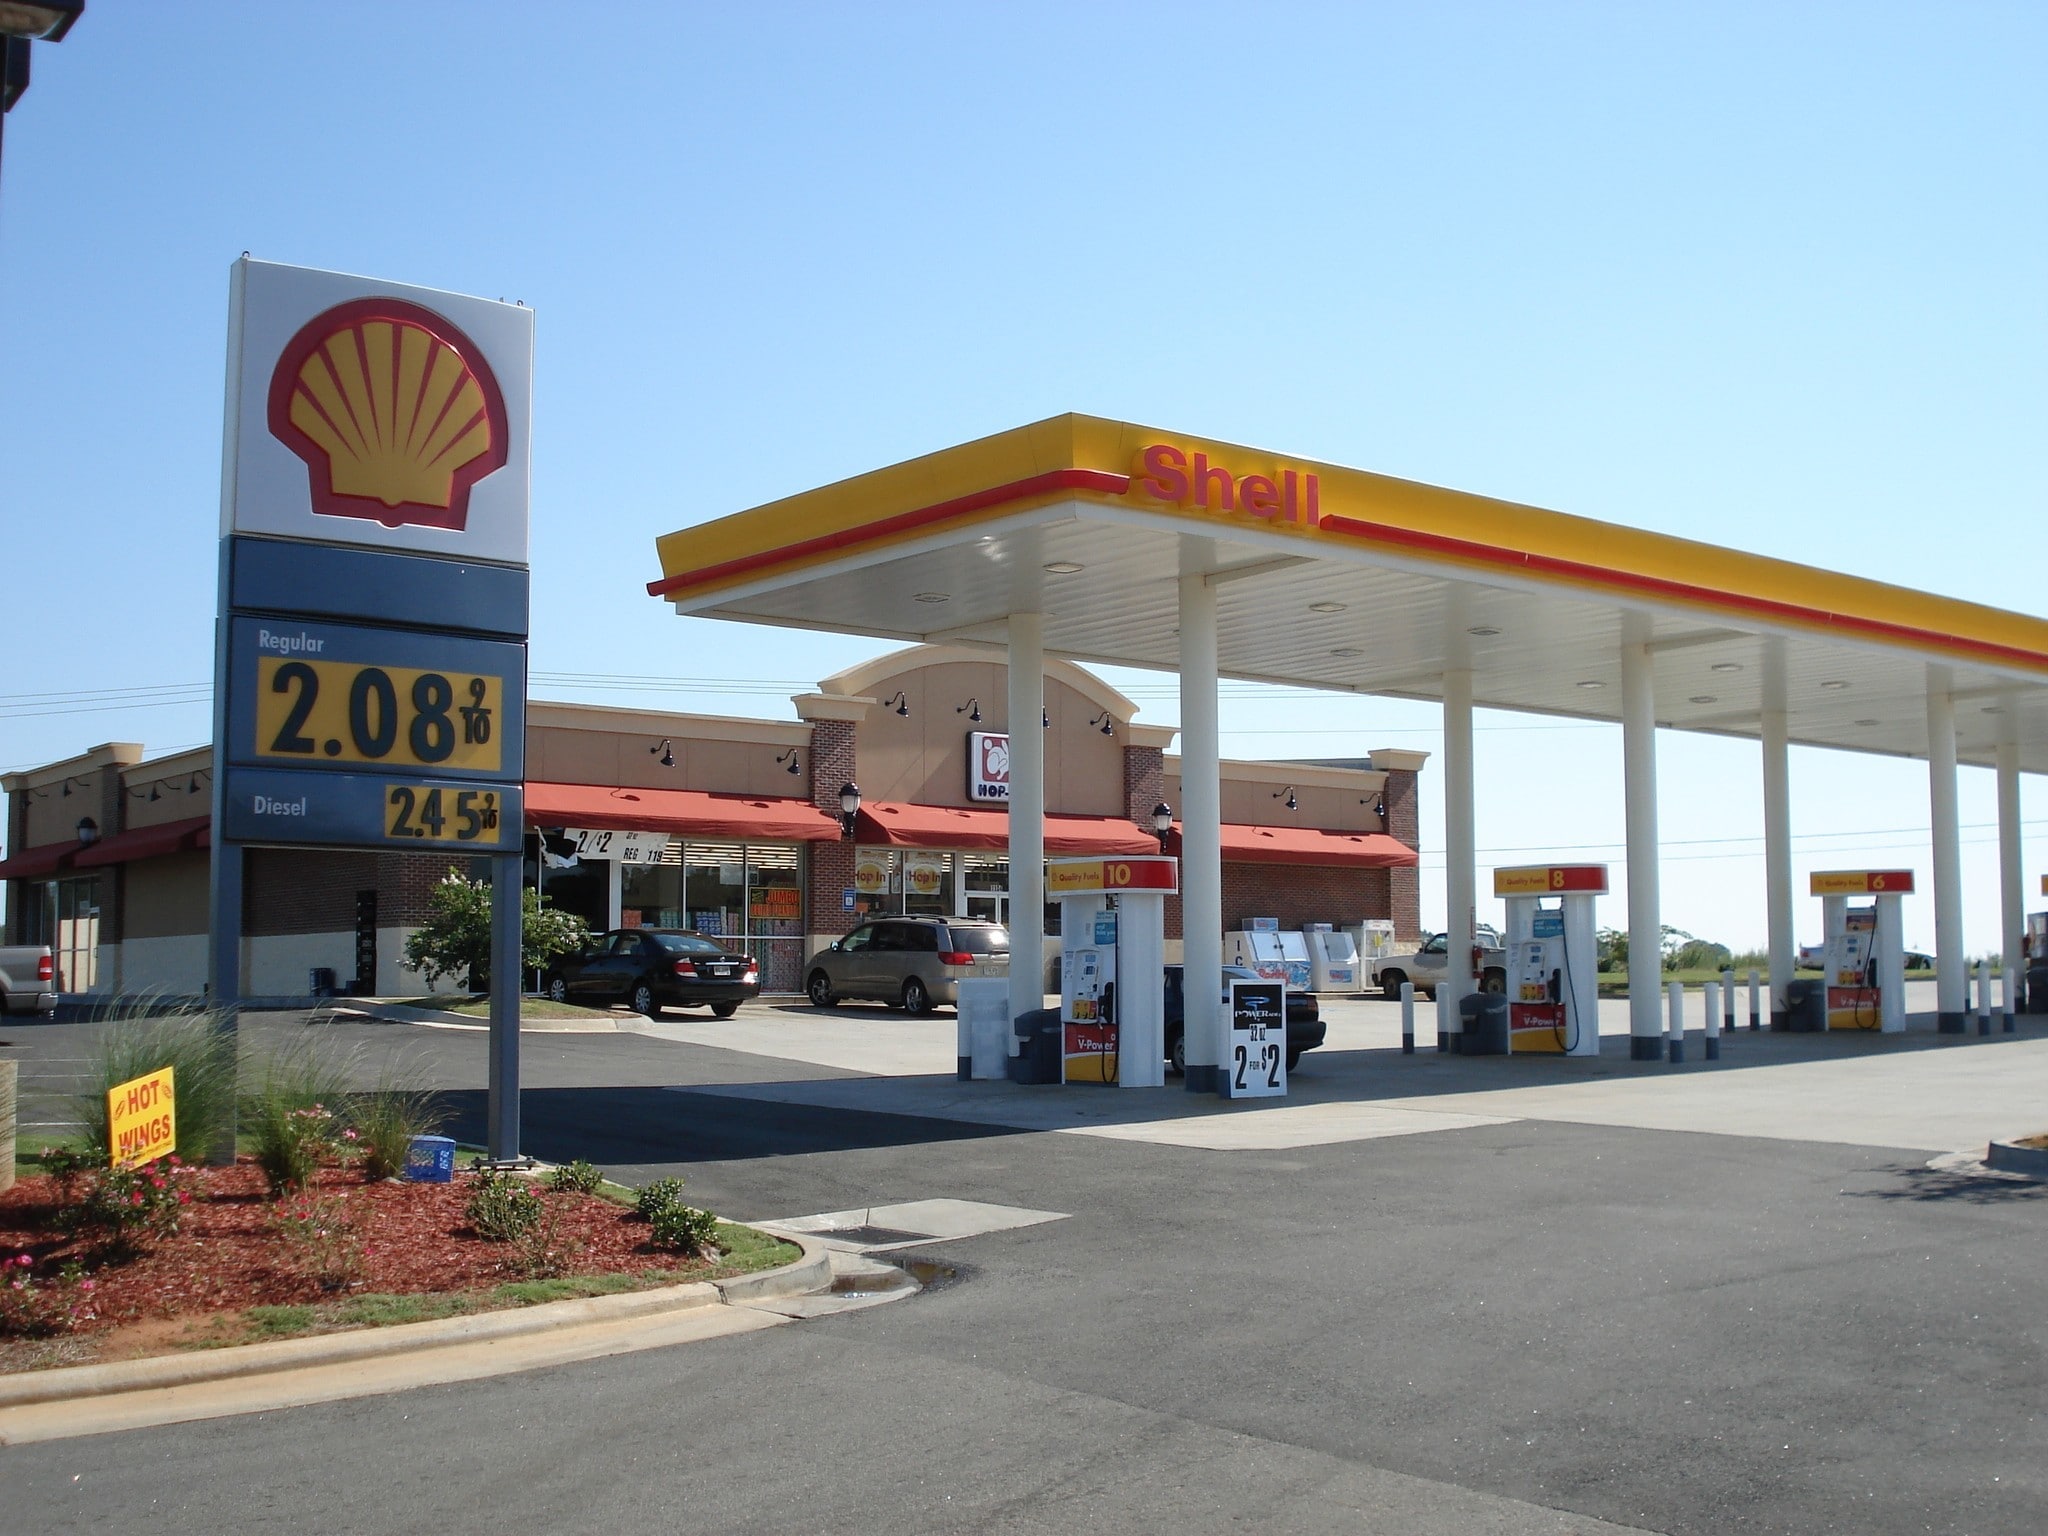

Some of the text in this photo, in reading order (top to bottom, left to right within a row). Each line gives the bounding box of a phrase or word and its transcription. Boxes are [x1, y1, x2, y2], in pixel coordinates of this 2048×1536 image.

[1142, 444, 1320, 526] Shell
[259, 629, 324, 655] Regular
[270, 662, 455, 763] 2.08
[977, 784, 1010, 797] HOP-
[253, 795, 306, 817] Diesel
[390, 787, 481, 840] 2.45
[623, 847, 639, 860] REG
[876, 871, 886, 882] In
[908, 870, 941, 885] Hop In
[1059, 872, 1082, 883] Quality
[1107, 863, 1131, 885] 10
[1552, 870, 1565, 888] 8
[1872, 874, 1885, 890] 6
[1249, 1024, 1258, 1042] 32
[1077, 1038, 1114, 1051] V-Power
[1234, 1045, 1247, 1090] 2
[1249, 1060, 1260, 1071] FOR
[127, 1080, 160, 1115] HOT
[118, 1114, 170, 1157] WINGS
